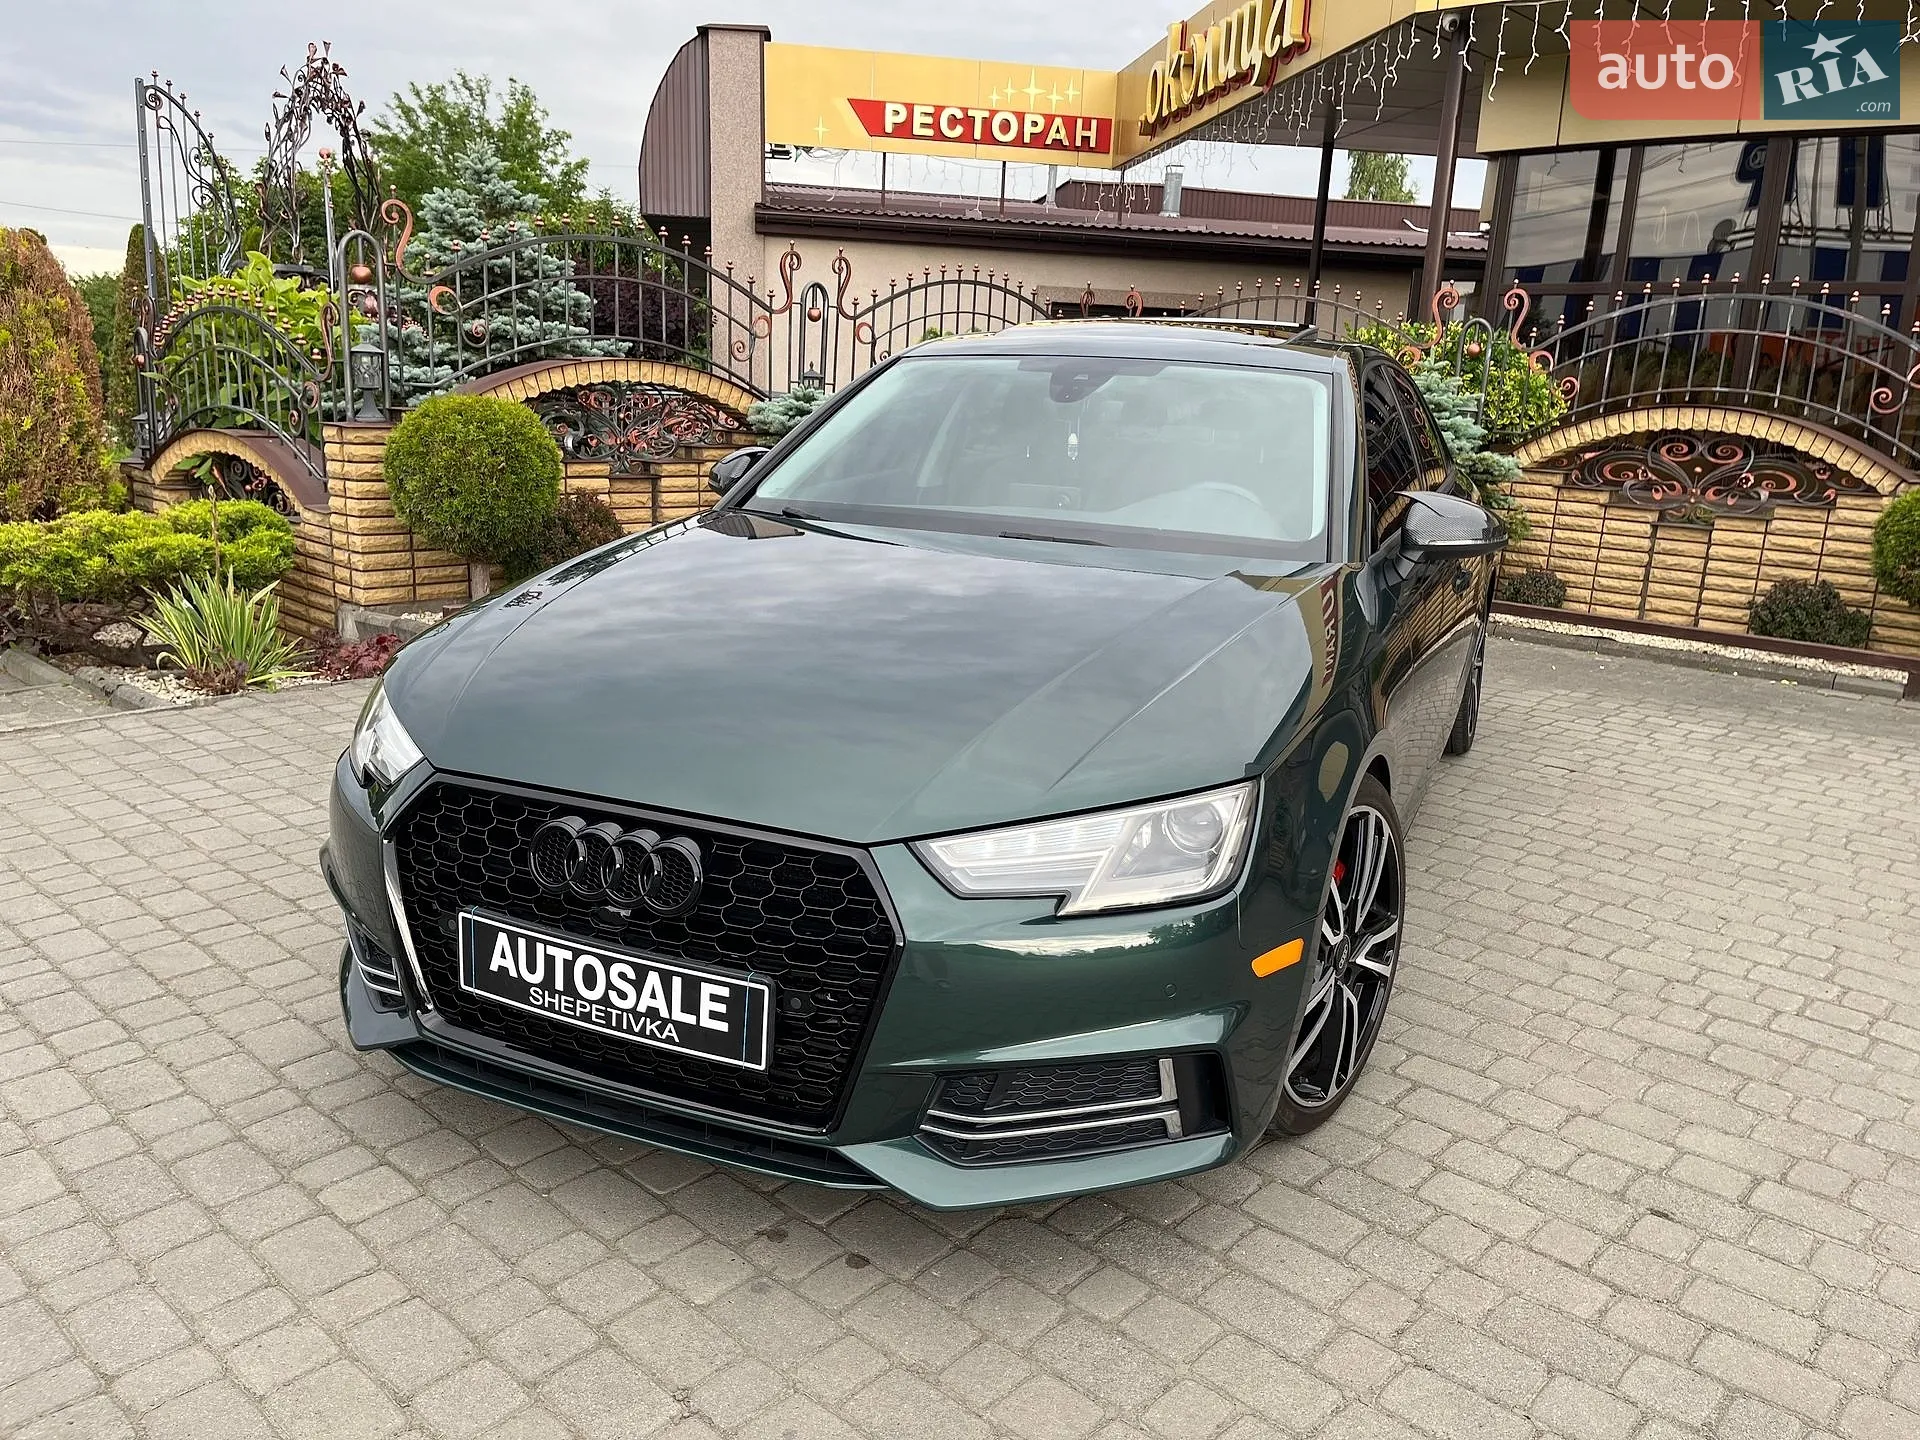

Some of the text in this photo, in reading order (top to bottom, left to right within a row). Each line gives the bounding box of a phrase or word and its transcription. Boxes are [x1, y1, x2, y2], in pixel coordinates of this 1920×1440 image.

[884, 101, 1098, 148] РЕСТОРАН
[489, 931, 730, 1033] AUTOSALE
[528, 987, 680, 1043] SHEPETIVKA
